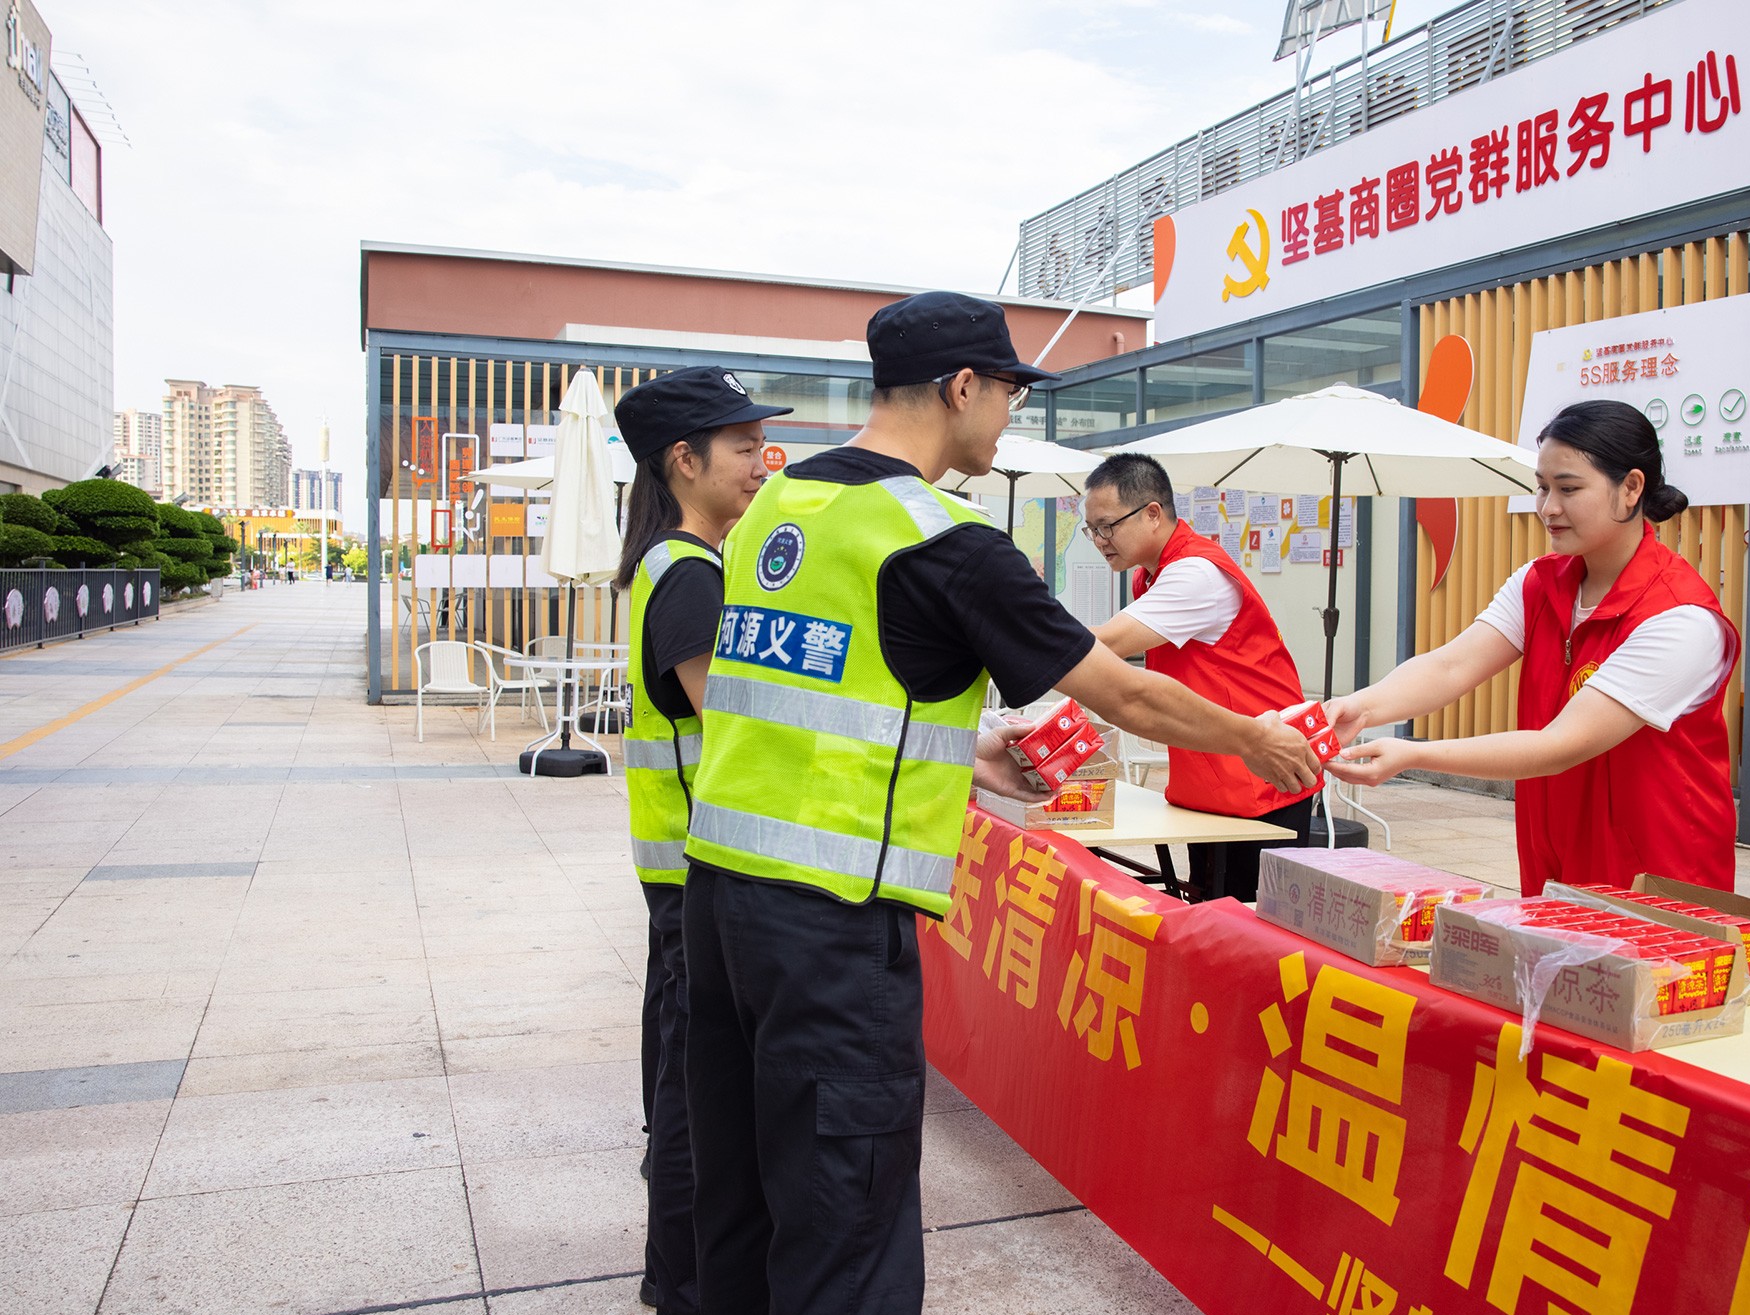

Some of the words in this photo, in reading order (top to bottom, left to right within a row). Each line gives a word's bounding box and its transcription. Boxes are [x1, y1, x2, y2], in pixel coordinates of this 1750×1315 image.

[1280, 50, 1742, 267] 坚基商圈党群服务中心
[1580, 352, 1680, 386] 5S服务理念
[718, 610, 847, 676] 河源义警
